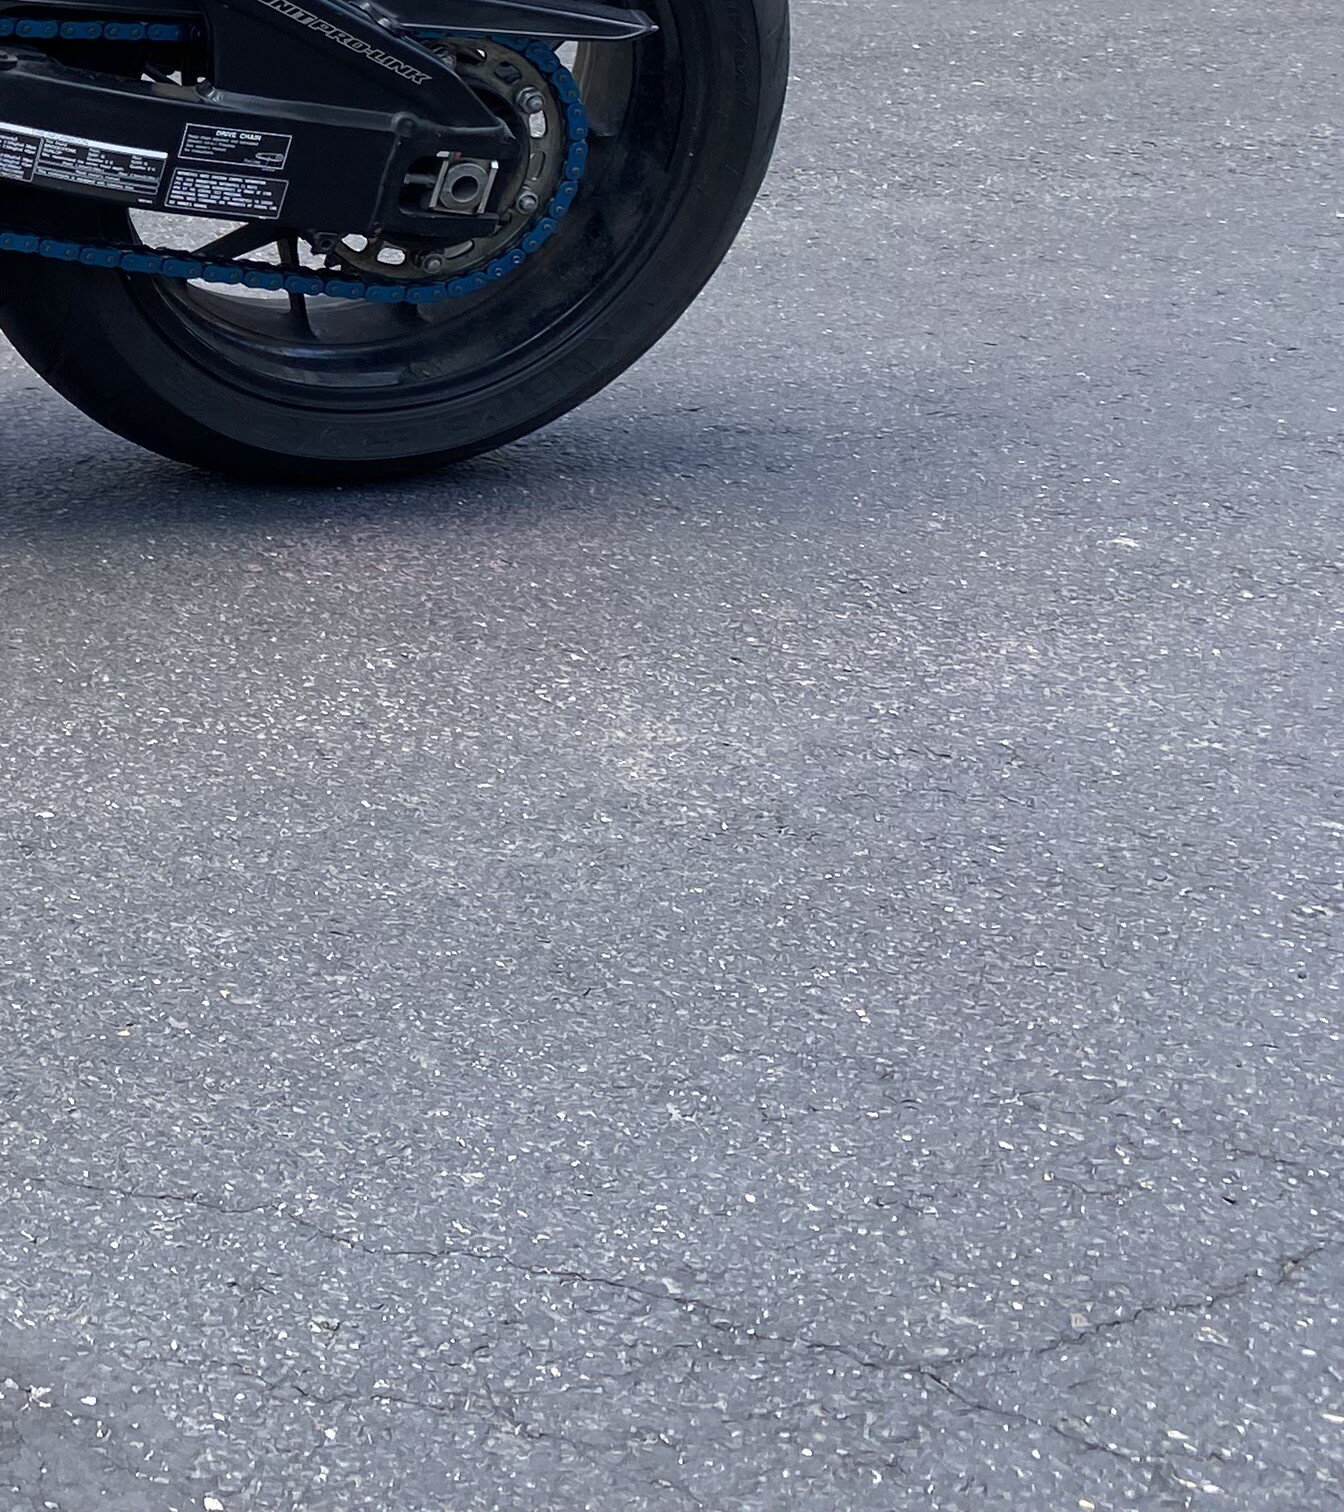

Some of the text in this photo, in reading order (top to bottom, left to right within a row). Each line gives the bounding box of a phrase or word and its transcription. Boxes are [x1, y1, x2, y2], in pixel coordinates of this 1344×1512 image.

[309, 17, 434, 86] PRO-LINK
[215, 130, 262, 141] DRIVE CHAIN
